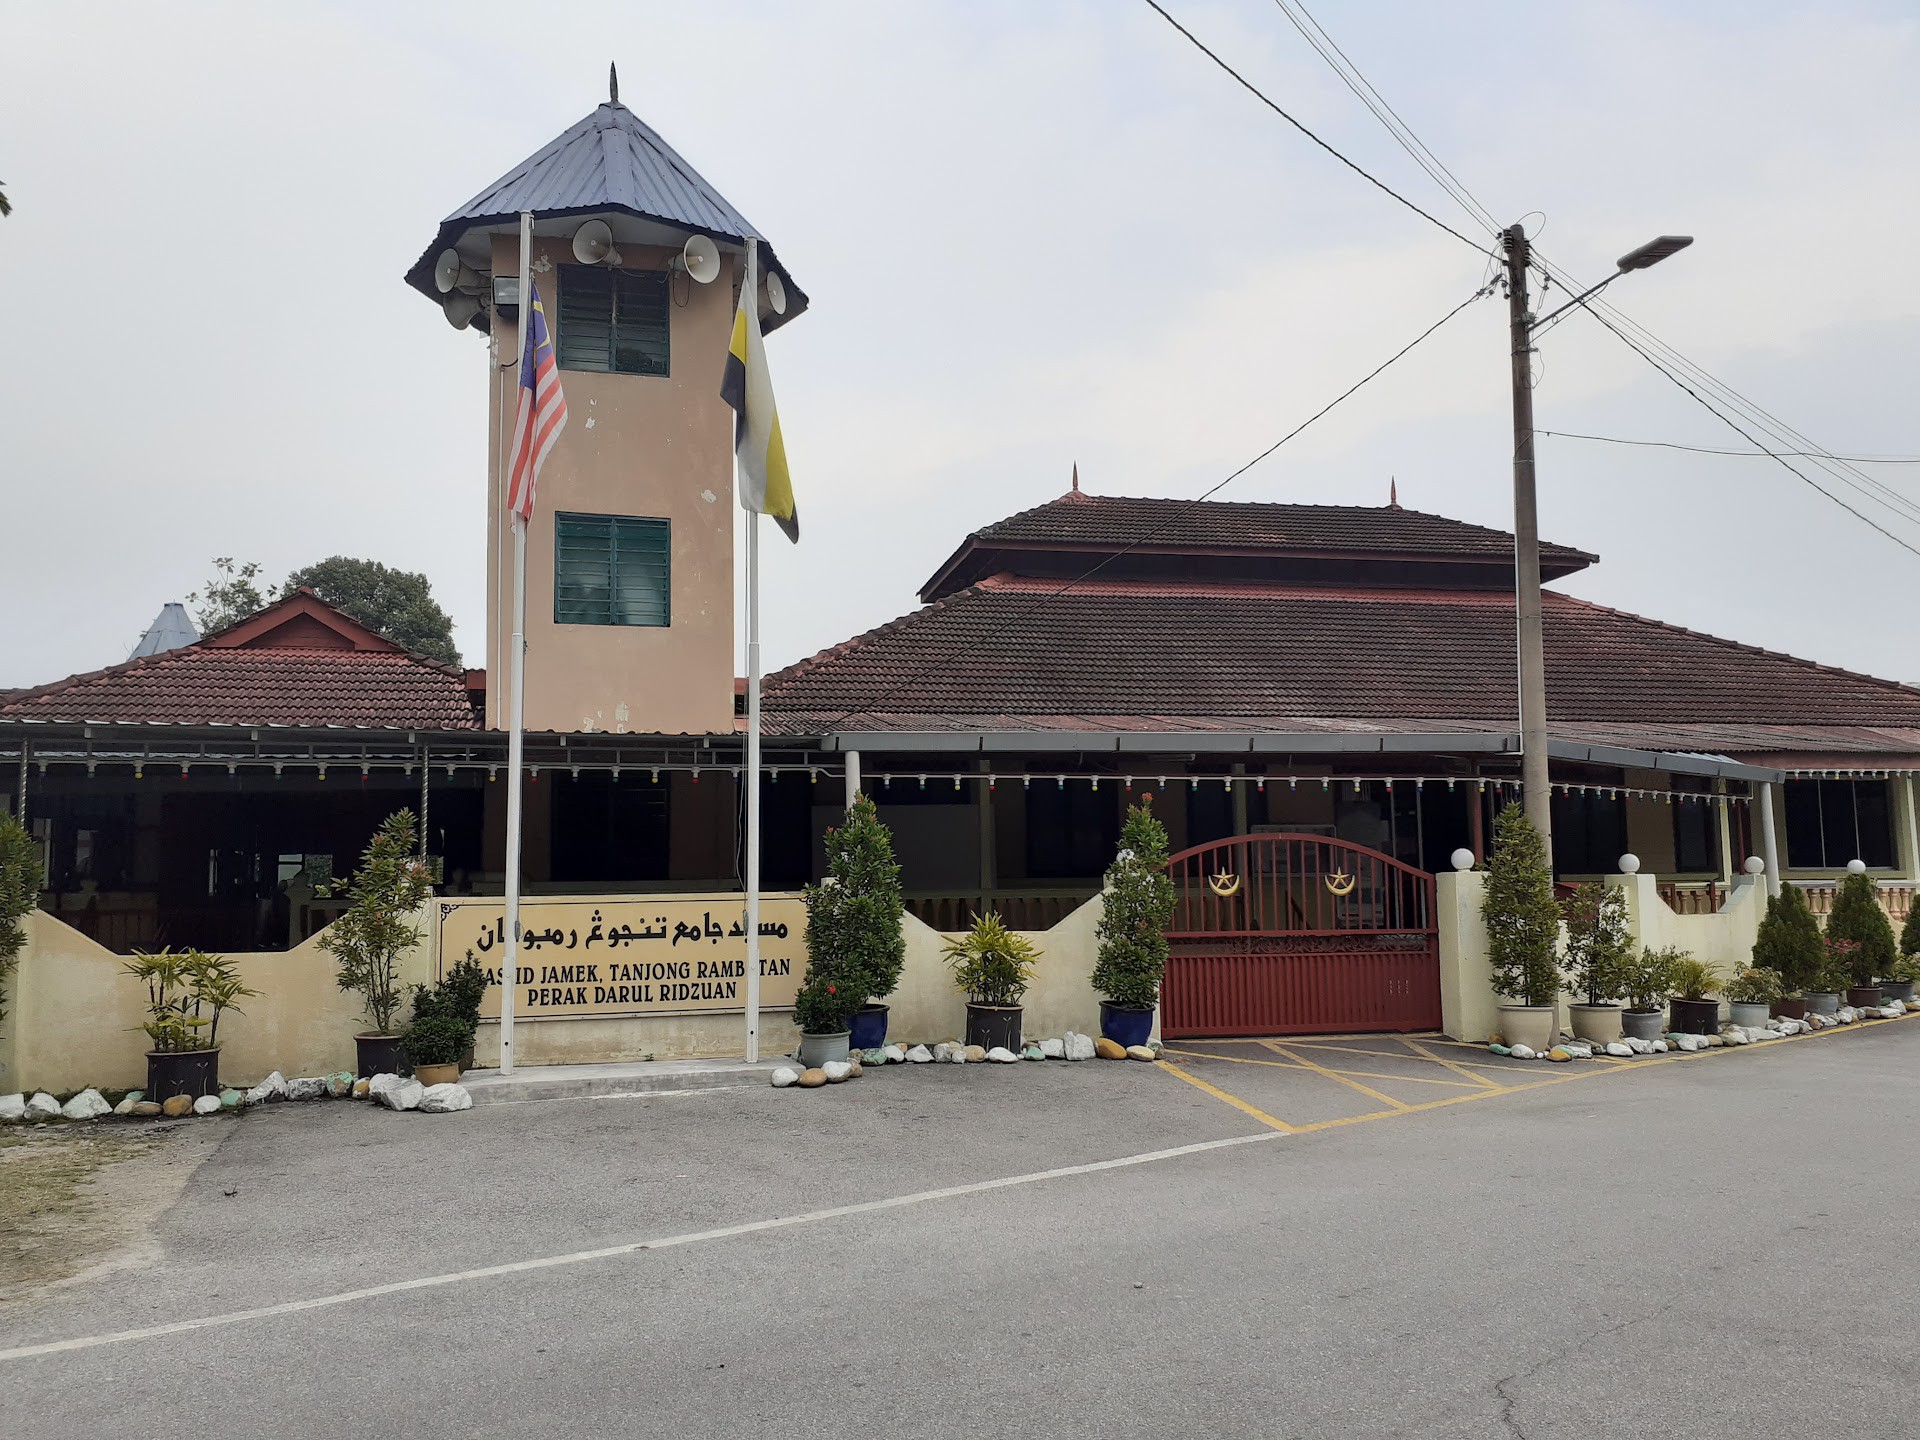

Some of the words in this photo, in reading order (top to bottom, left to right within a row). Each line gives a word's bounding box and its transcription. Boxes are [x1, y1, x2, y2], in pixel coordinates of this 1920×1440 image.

[476, 916, 578, 952] رمبوان
[673, 911, 724, 947] جامع
[728, 920, 788, 944] مسد
[477, 967, 535, 986] ASID
[540, 964, 603, 985] JAMEK,
[609, 962, 690, 982] TANJONG
[697, 958, 791, 978] RAMBTAN
[527, 986, 588, 1006] PERAK
[594, 983, 654, 1003] DARUL
[659, 981, 737, 1002] RIDZUAN
